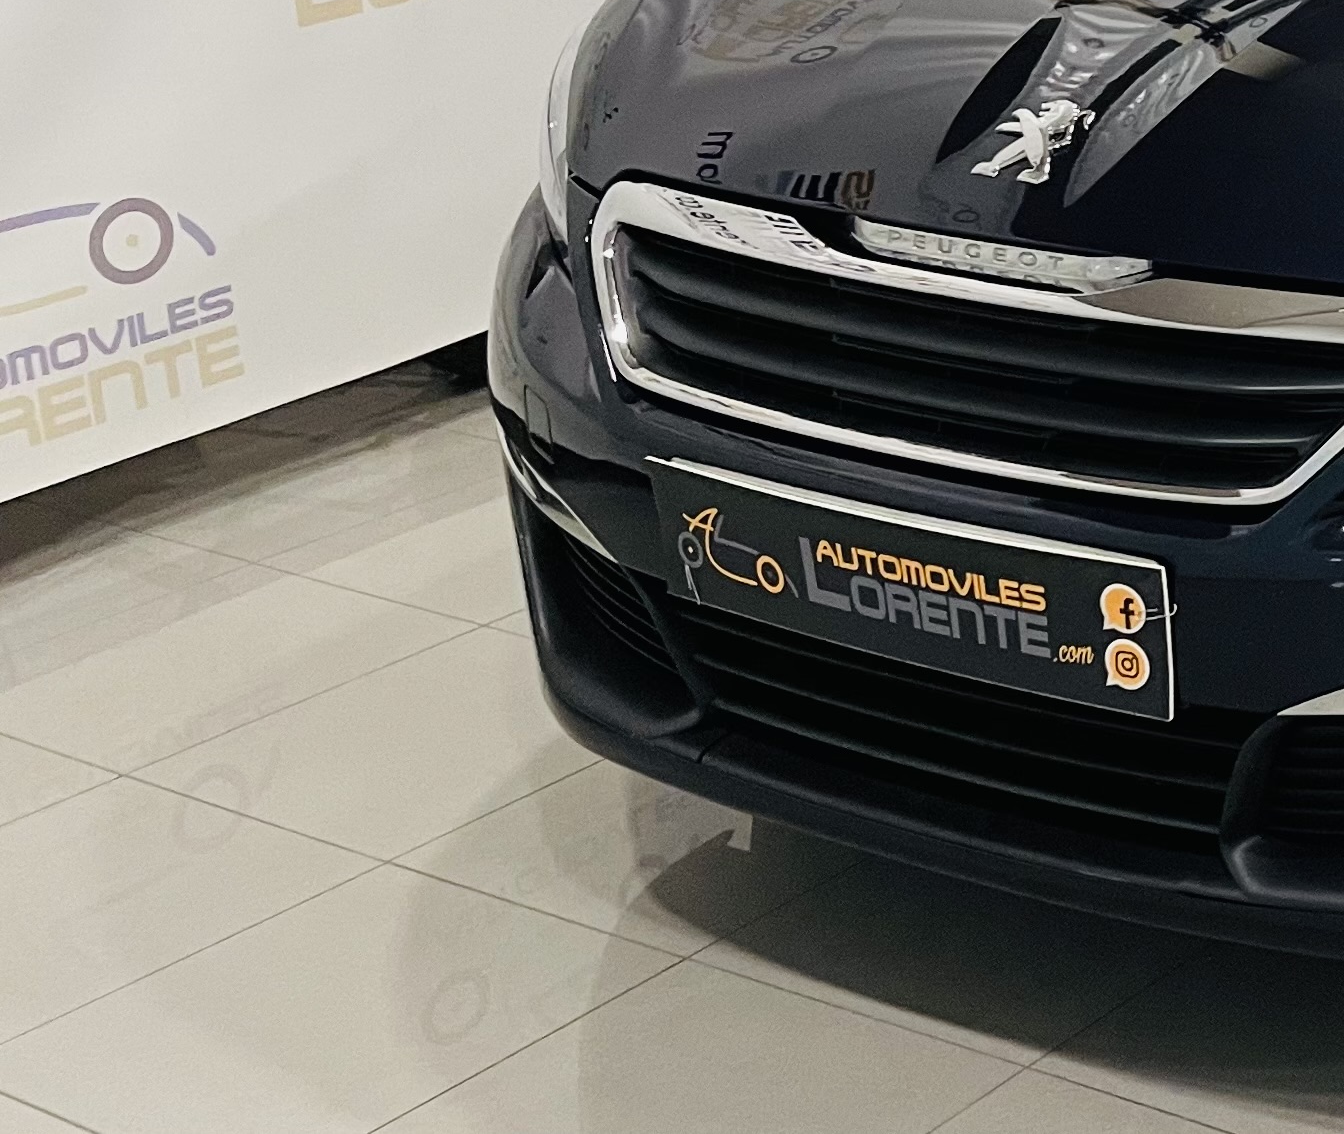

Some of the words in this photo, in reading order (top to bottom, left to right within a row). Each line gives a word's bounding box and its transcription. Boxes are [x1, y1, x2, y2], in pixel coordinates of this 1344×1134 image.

[887, 230, 1063, 267] PEUGEOT
[0, 285, 235, 388] MOVILES
[800, 536, 1051, 657] LORENTE
[816, 540, 1046, 611] AUTOMOVILES
